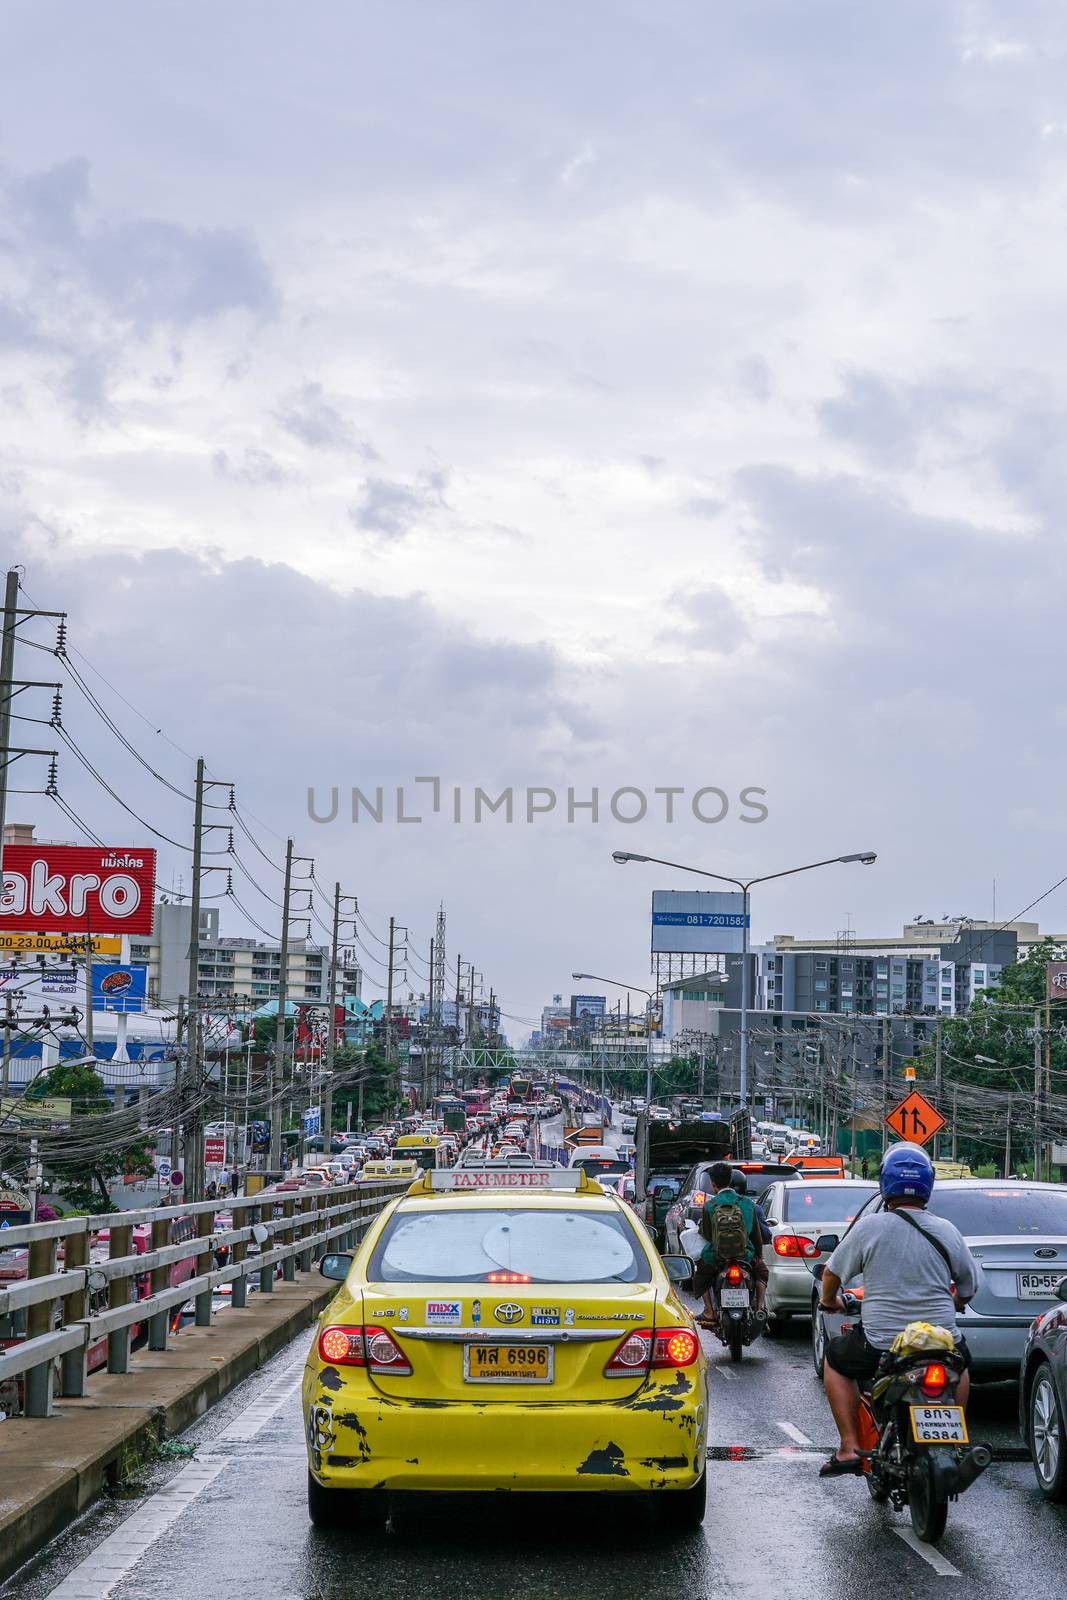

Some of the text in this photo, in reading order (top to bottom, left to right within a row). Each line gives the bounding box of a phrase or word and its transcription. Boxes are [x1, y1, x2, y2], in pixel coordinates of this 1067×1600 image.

[1039, 1249, 1053, 1257] Ford
[608, 1313, 646, 1321] ALTIS
[476, 1347, 546, 1364] ทส 6996
[922, 1430, 959, 1440] 6384
